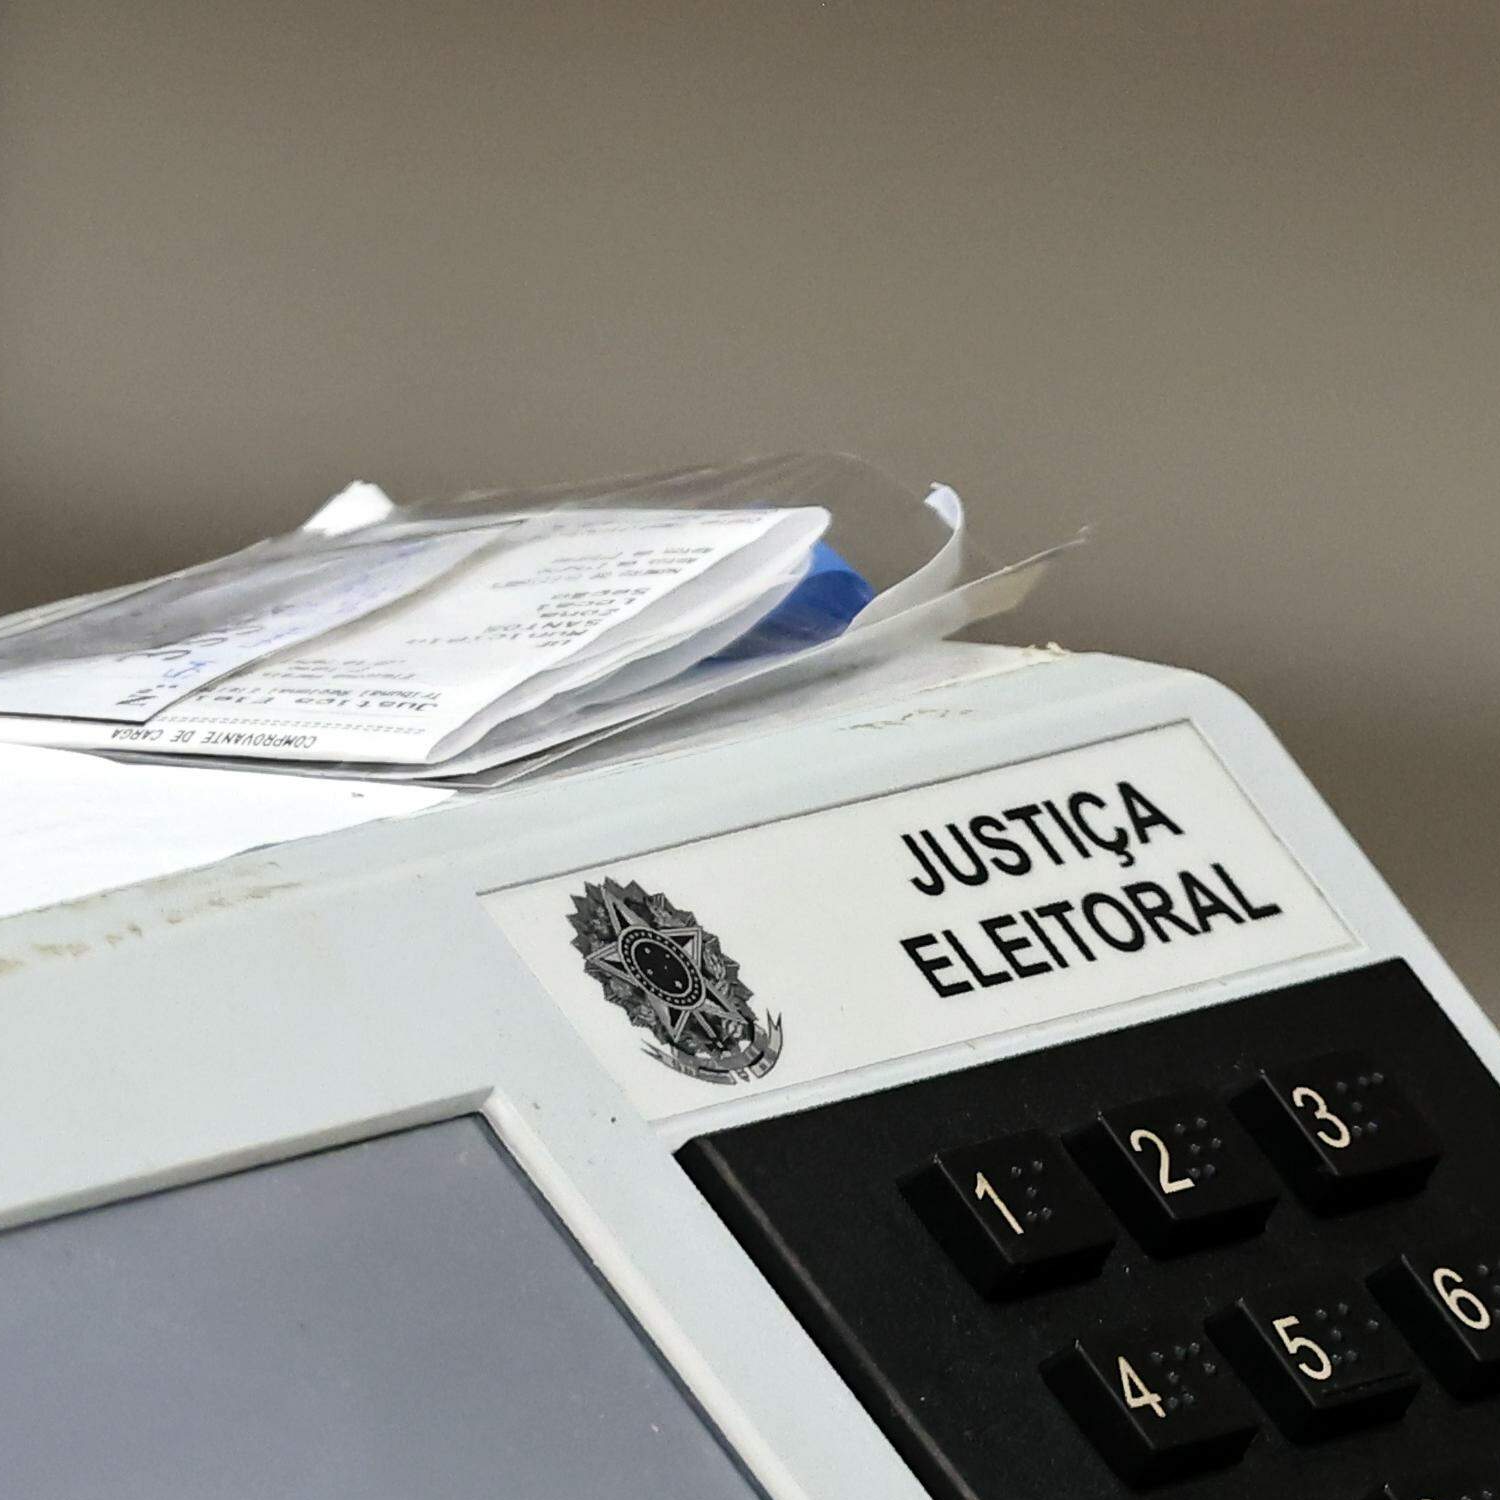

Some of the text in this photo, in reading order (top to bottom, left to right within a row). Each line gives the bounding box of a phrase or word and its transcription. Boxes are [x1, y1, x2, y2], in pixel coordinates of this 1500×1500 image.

[111, 727, 318, 749] COMPROVANTE DE CARGA
[901, 782, 1183, 896] JUSTIÇA
[900, 871, 1282, 998] ELEITORAL
[1293, 1087, 1350, 1147] 3
[1131, 1130, 1194, 1193] 2
[975, 1173, 1023, 1234] 1
[1434, 1269, 1489, 1329] 6
[1273, 1316, 1331, 1379] 5
[1119, 1357, 1165, 1417] 4
